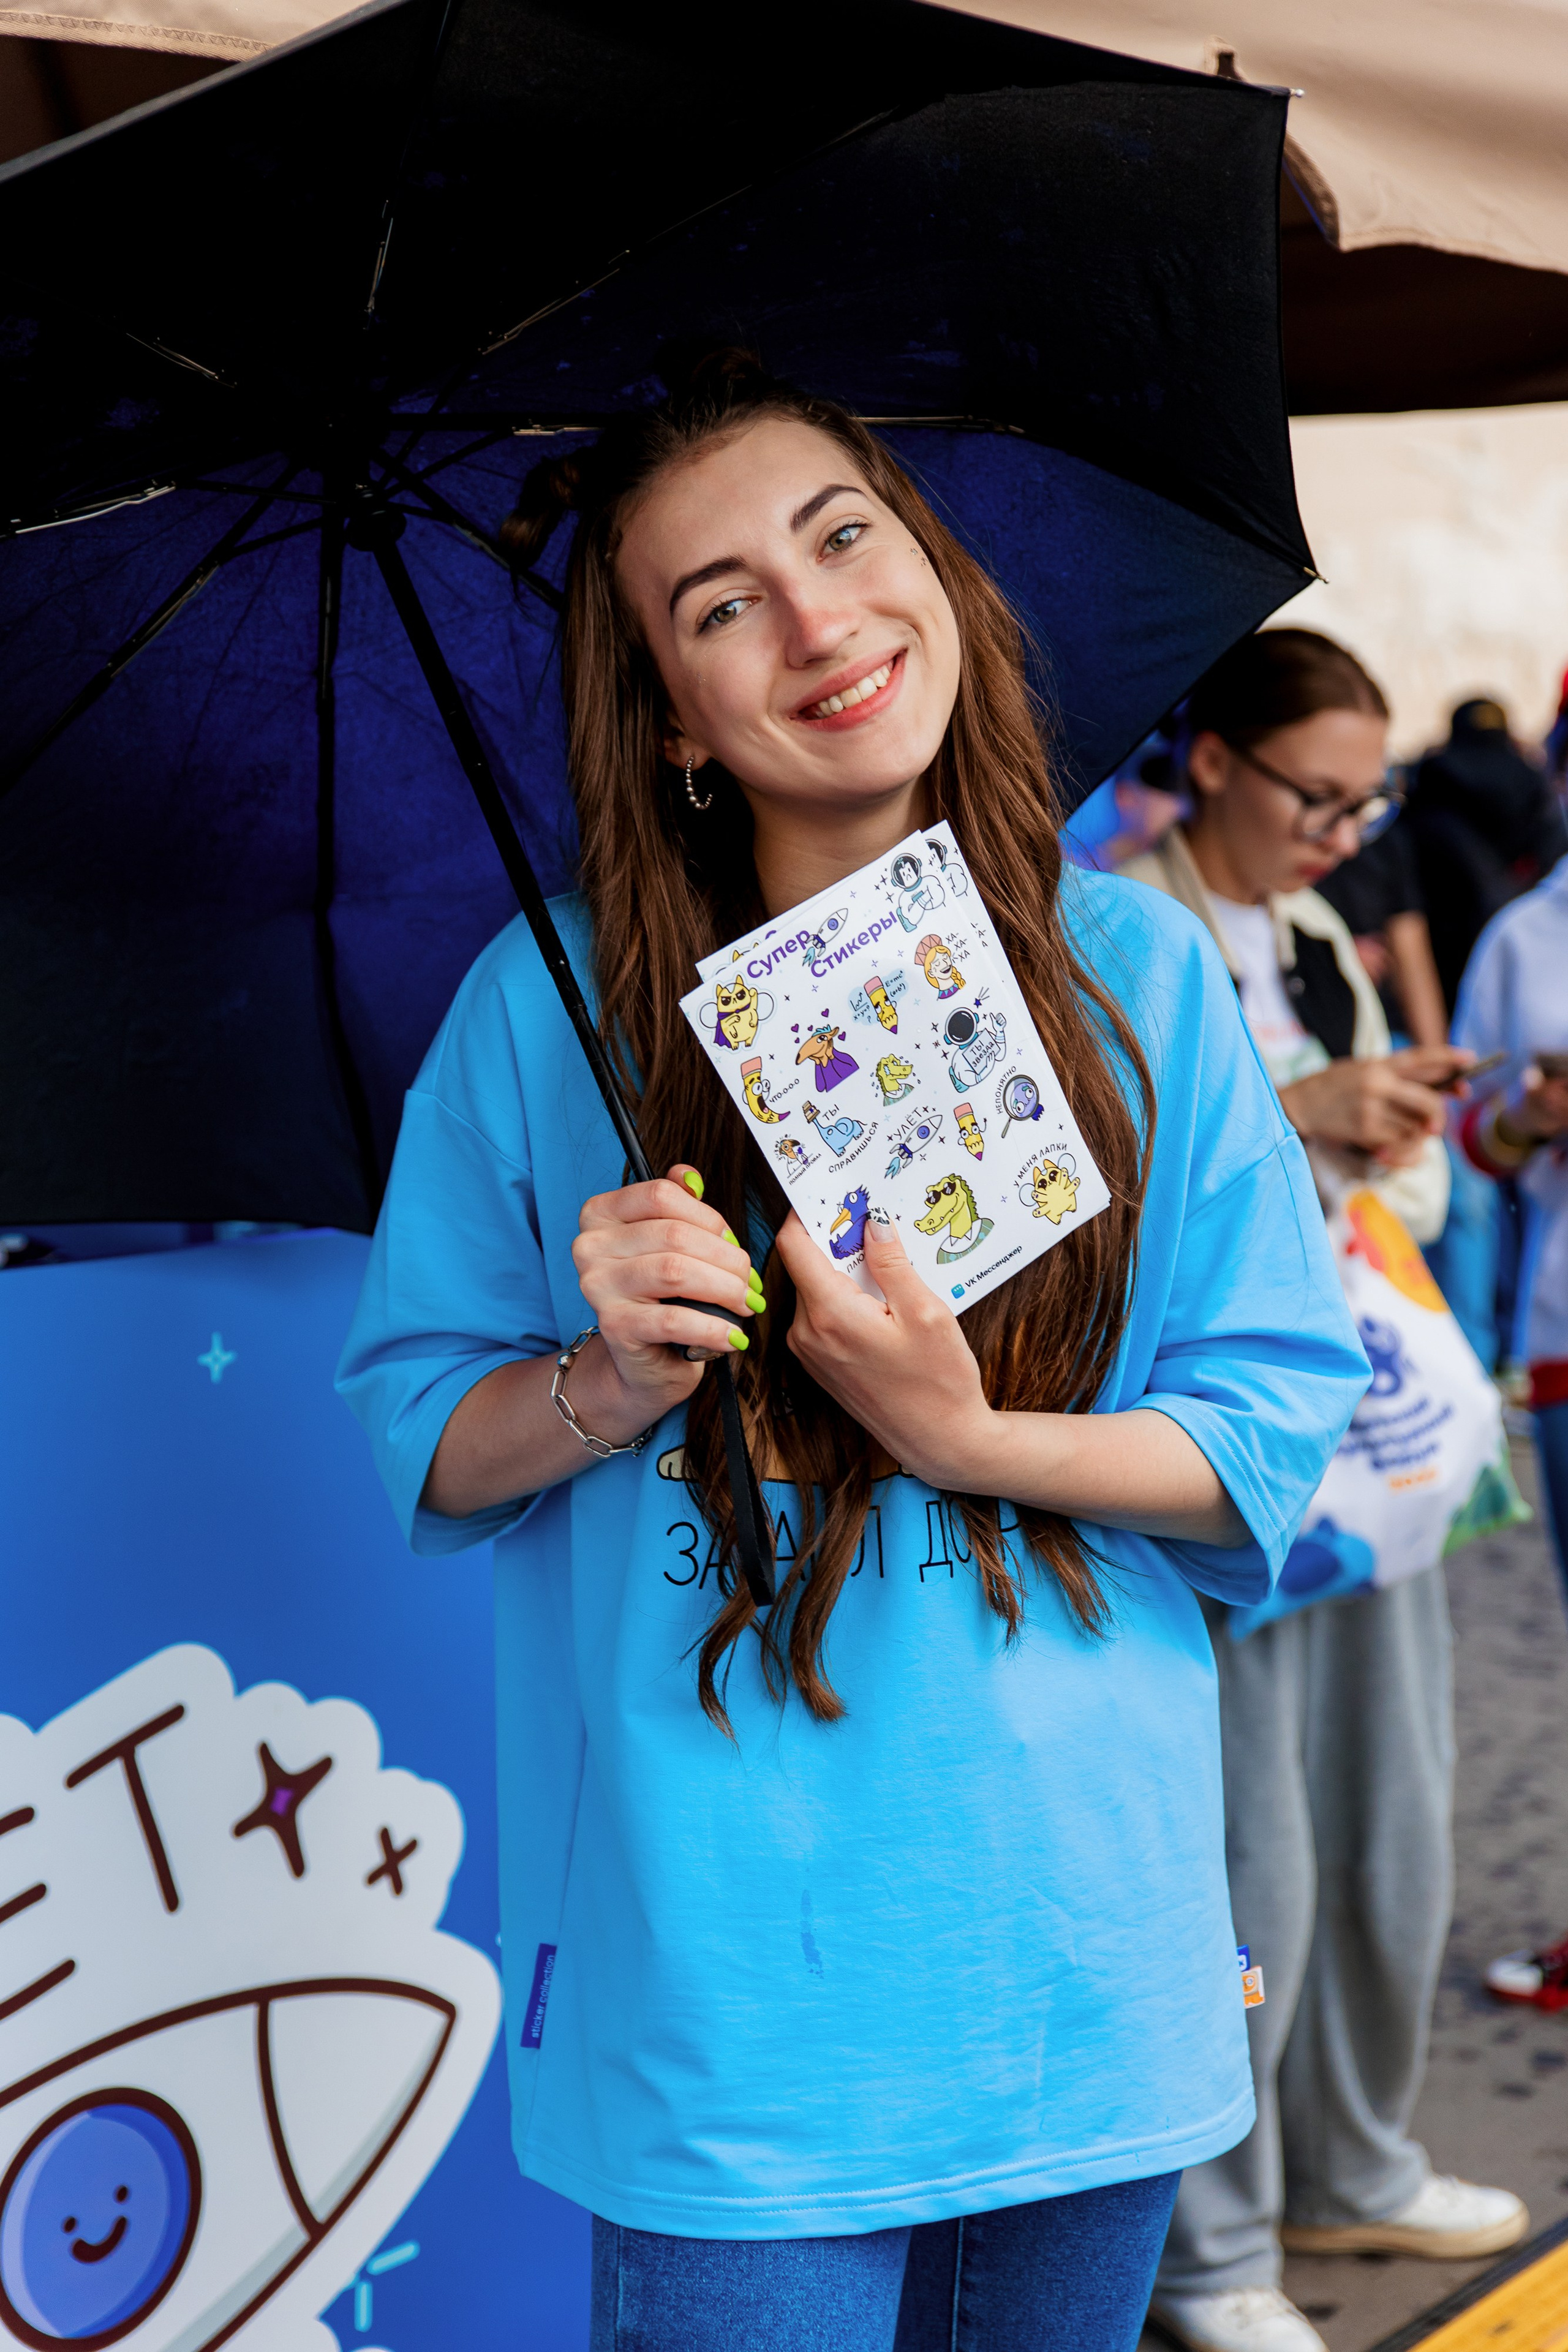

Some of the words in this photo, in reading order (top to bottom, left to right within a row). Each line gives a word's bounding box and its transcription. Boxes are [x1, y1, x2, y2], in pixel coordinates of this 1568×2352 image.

[747, 930, 810, 978] Супер
[811, 911, 898, 978] Стикеры
[970, 1039, 984, 1055] ТЫ
[995, 1066, 1016, 1114] НЕПОНЯТНО
[822, 1104, 840, 1121] ТЫ
[894, 1107, 922, 1140] УЛЁТ
[829, 1121, 879, 1173] СПРАВИШЬСЯ
[1017, 1154, 1038, 1180] МЕНЯ
[1039, 1143, 1068, 1158] ЛАПКИ
[965, 1276, 977, 1287] VK
[976, 1246, 1022, 1281] Мессенджер
[532, 2004, 545, 2038] sticker
[539, 1954, 555, 2003] collection
